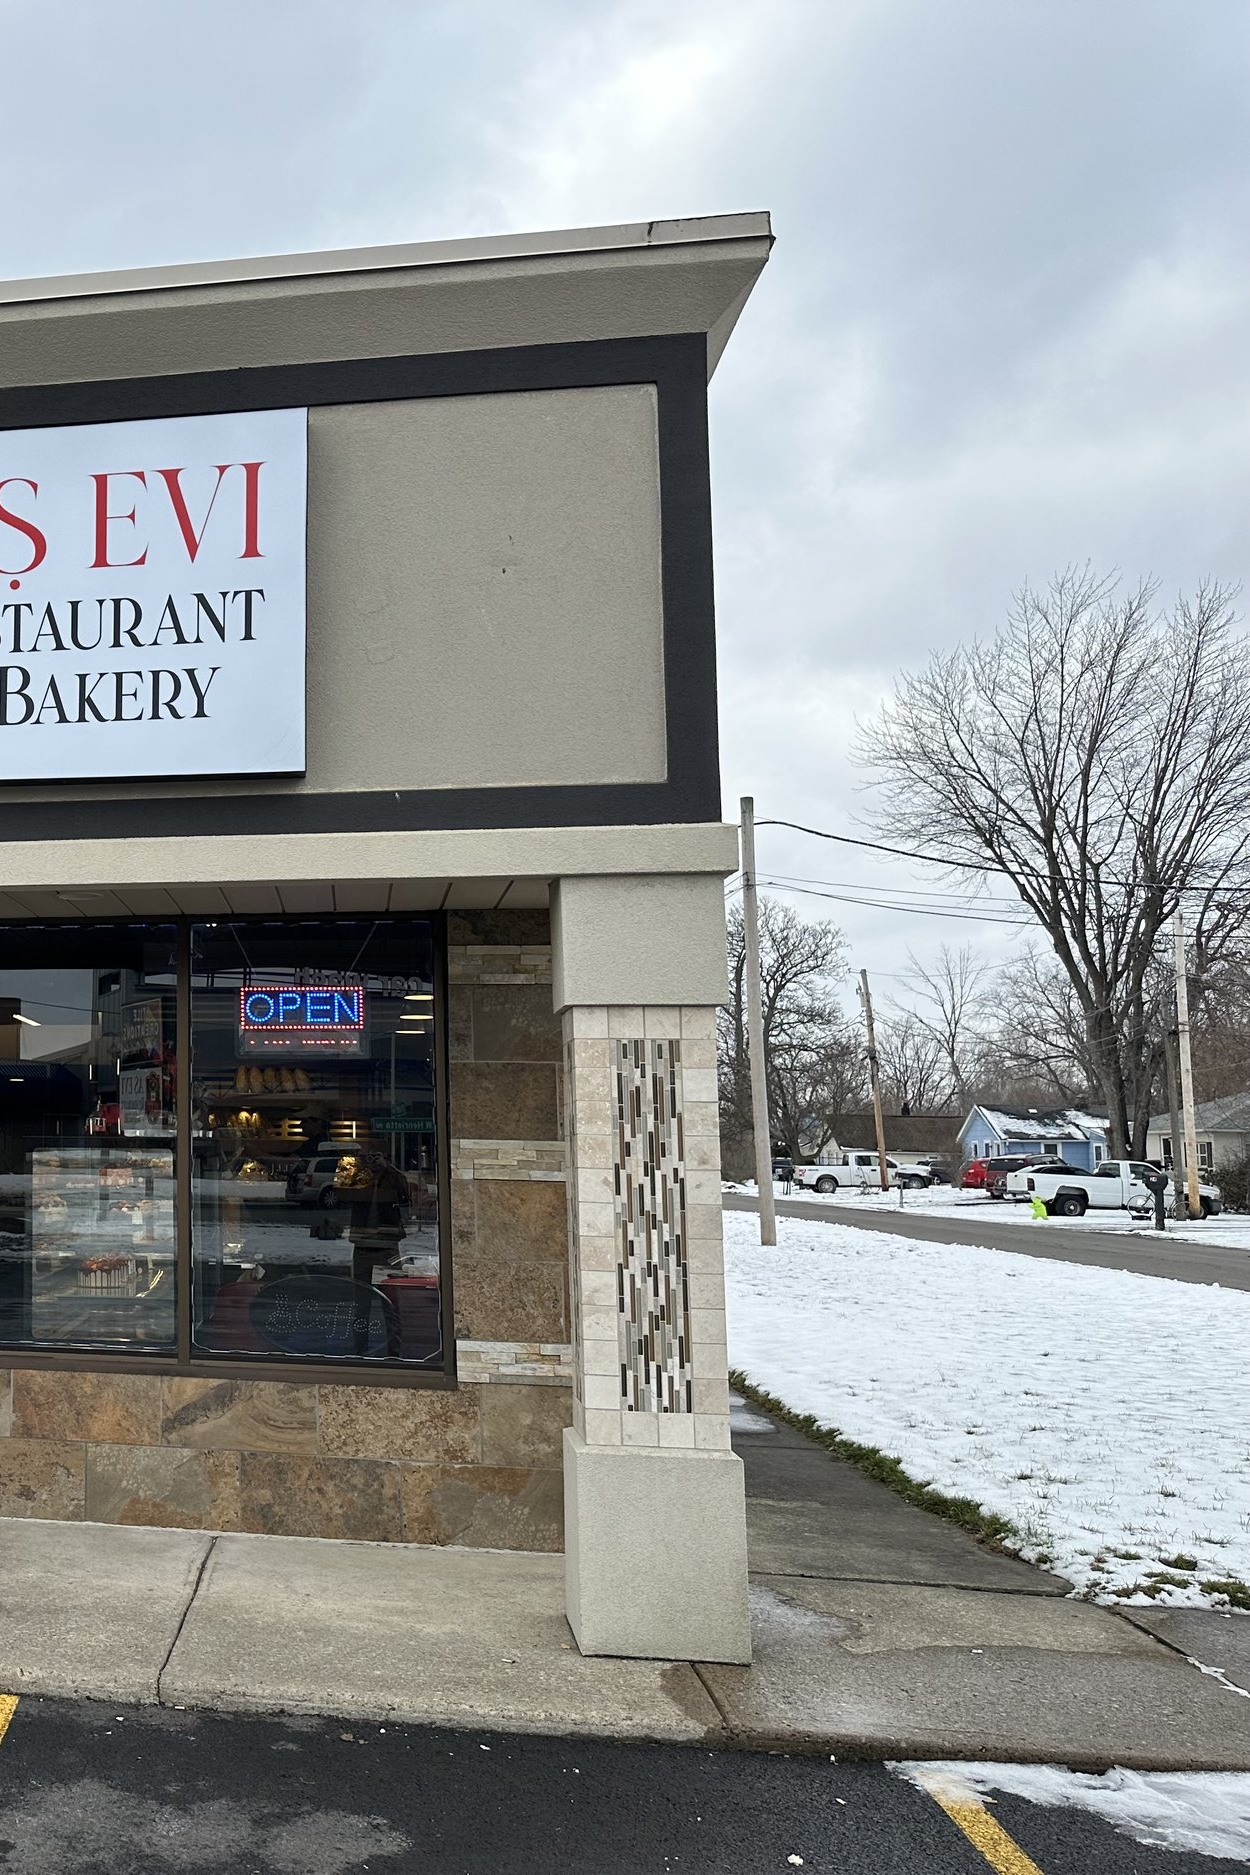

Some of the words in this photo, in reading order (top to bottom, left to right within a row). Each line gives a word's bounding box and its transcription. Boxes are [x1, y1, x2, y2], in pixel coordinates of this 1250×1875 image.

[88, 461, 267, 568] EVI
[245, 991, 359, 1023] OPEN
[295, 1298, 383, 1340] Coffee
